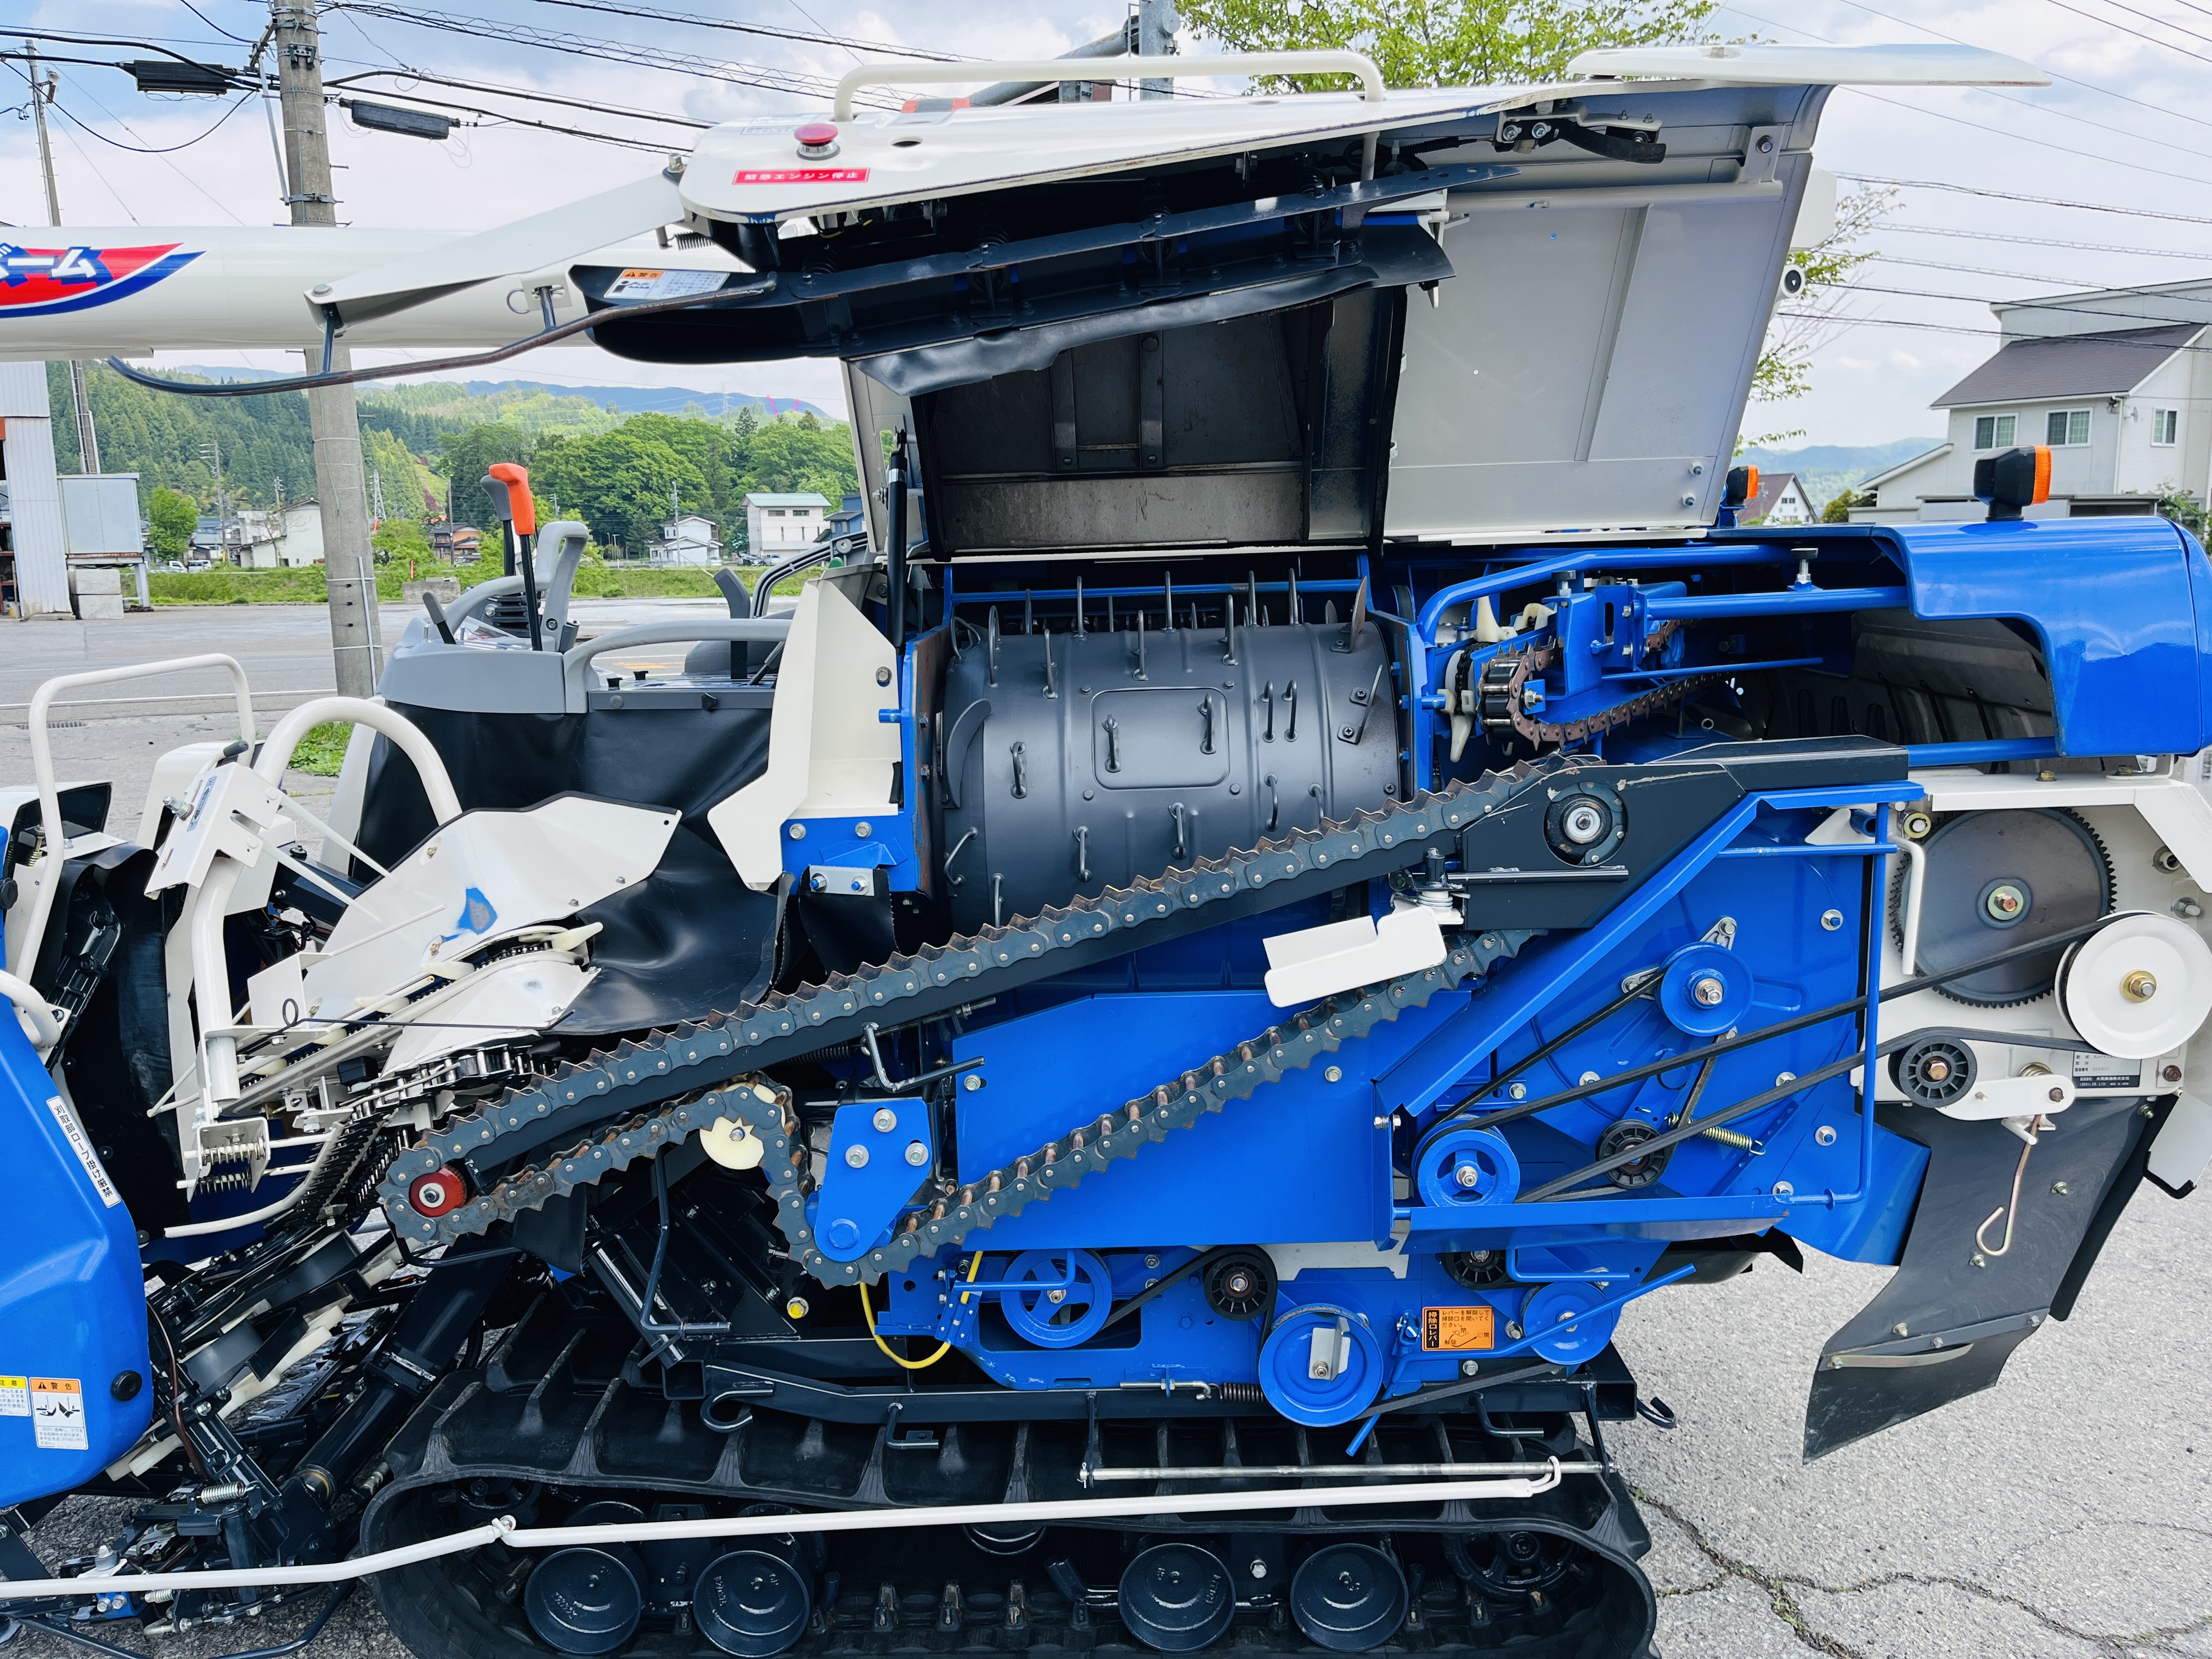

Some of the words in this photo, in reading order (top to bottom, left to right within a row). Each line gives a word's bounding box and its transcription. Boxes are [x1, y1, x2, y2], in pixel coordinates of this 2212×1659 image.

[744, 172, 858, 180] 緊急エンジン停止
[54, 1104, 113, 1198] 刈取部ロープ掛け厳禁
[1428, 1311, 1438, 1347] 掃除口レバー
[50, 1382, 72, 1391] 警告
